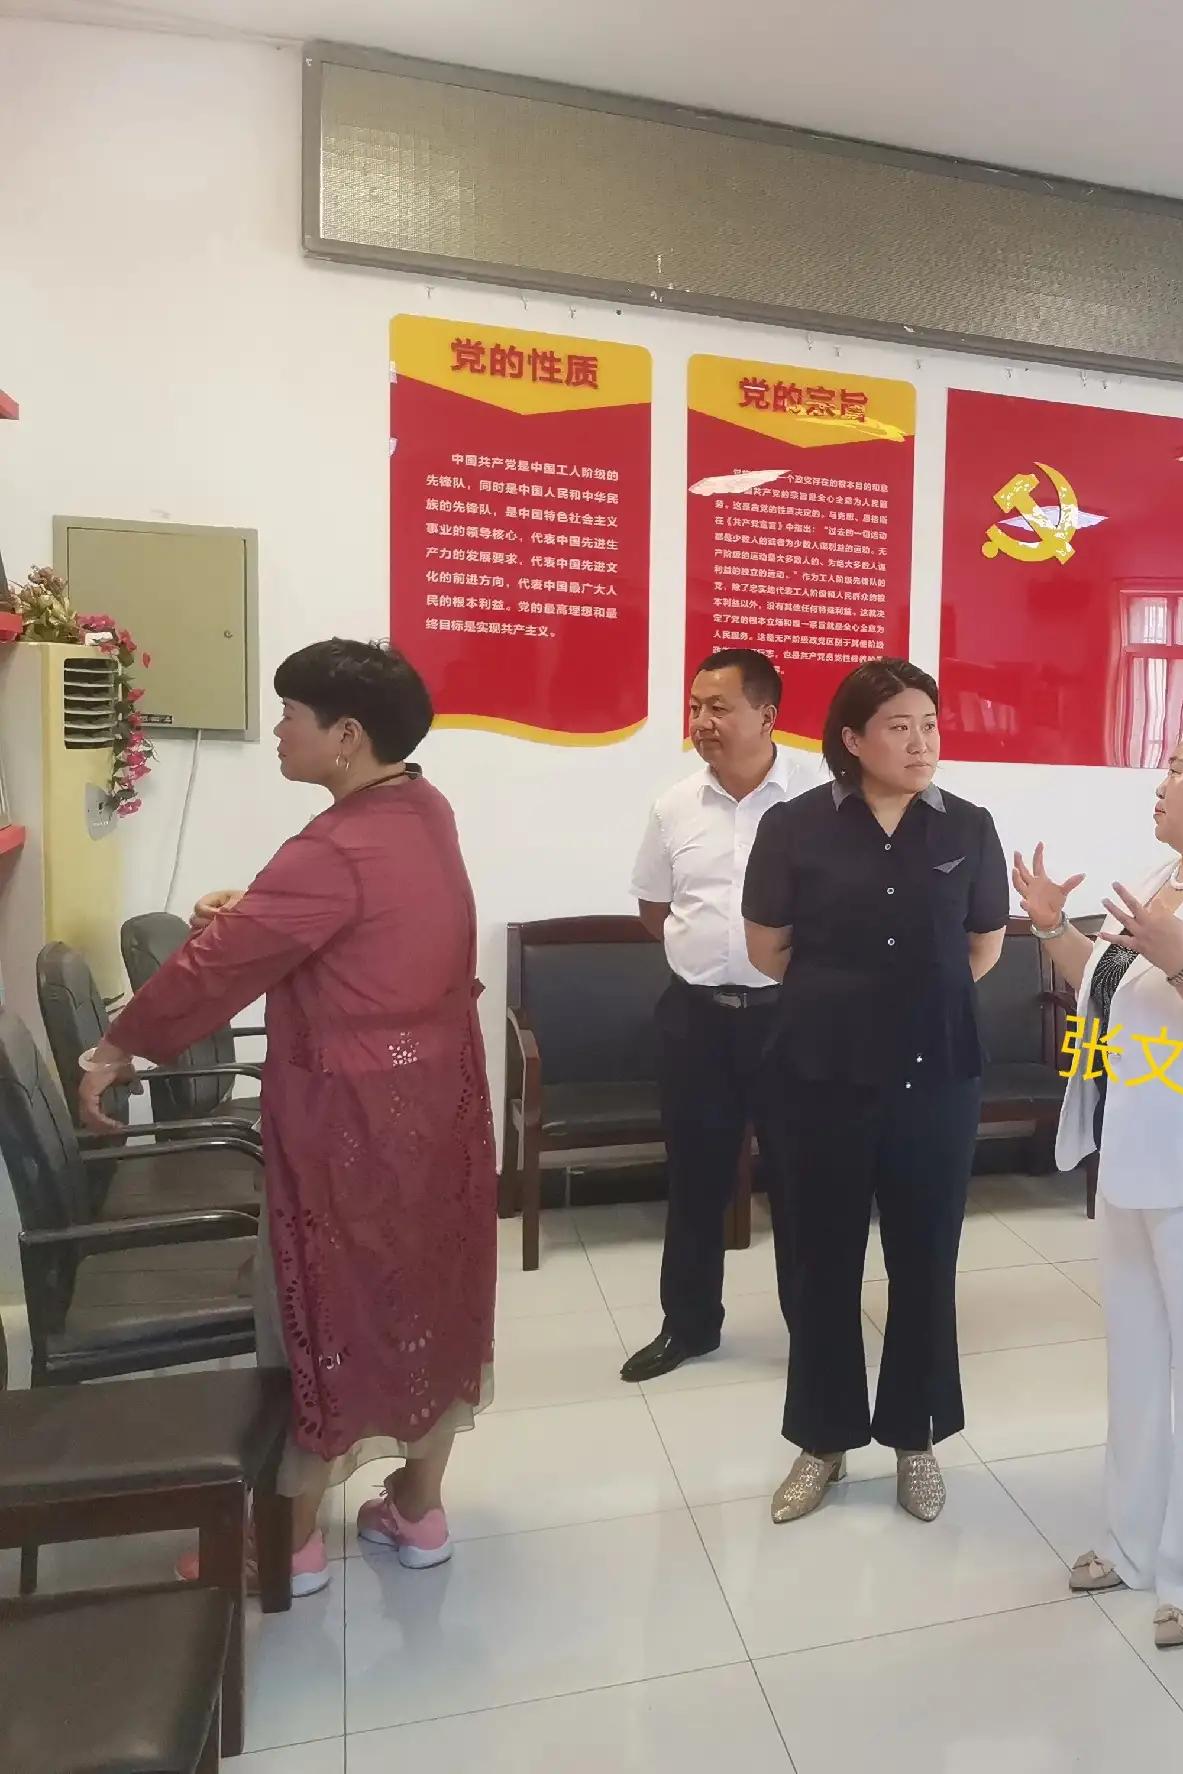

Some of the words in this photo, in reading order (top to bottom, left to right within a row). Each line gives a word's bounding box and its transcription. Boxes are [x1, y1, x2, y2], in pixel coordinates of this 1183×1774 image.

[450, 337, 599, 389] 党的性质
[738, 376, 868, 423] 党的宗旨
[451, 453, 619, 482] 中国共产党是中国工人阶级的
[426, 474, 619, 505] 先锋队，同时是中国人民和中华民
[426, 498, 619, 528] 族的先锋队，是中国特色社会主义
[426, 522, 619, 550] 事业的领导核心，代表中国先进生
[426, 547, 619, 573] 产力的发展要求，代表中国先进文
[426, 571, 618, 596] 化的前进方向，代表中国最广大人
[426, 595, 618, 619] 民的根本利益。党的最高理想和最
[425, 618, 556, 638] 终目标是实现共产主义。
